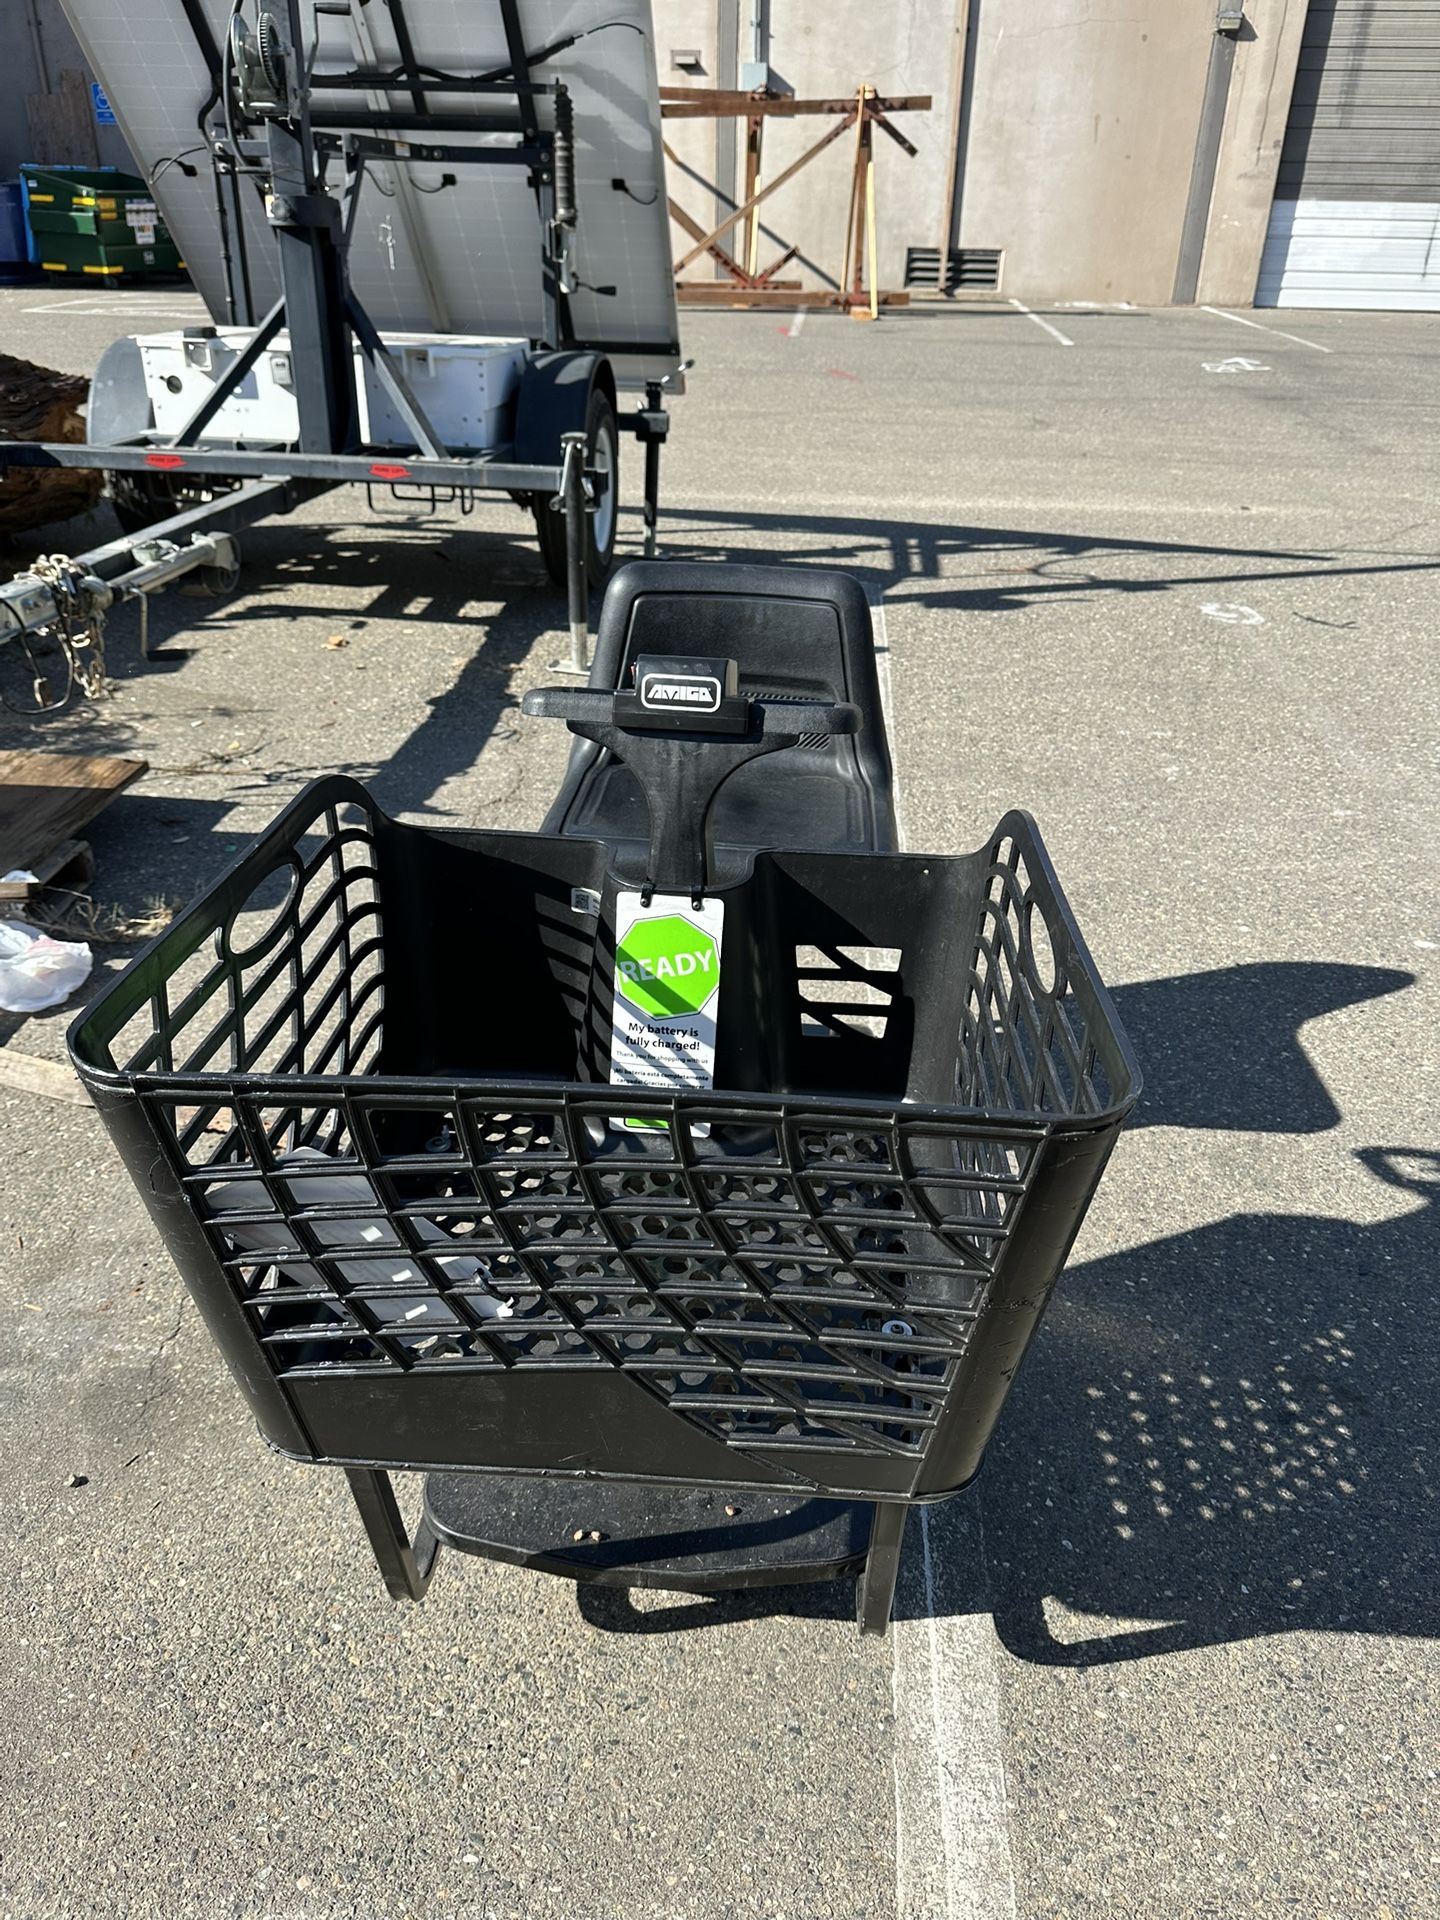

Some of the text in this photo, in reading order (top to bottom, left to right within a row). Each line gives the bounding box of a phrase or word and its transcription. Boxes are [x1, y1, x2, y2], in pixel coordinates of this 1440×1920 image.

[646, 684, 714, 702] AMIGA
[620, 949, 712, 983] READY
[628, 1022, 699, 1038] My battery is
[625, 1036, 700, 1052] fully charged!
[616, 1050, 634, 1058] Thank
[658, 1055, 685, 1064] shopping
